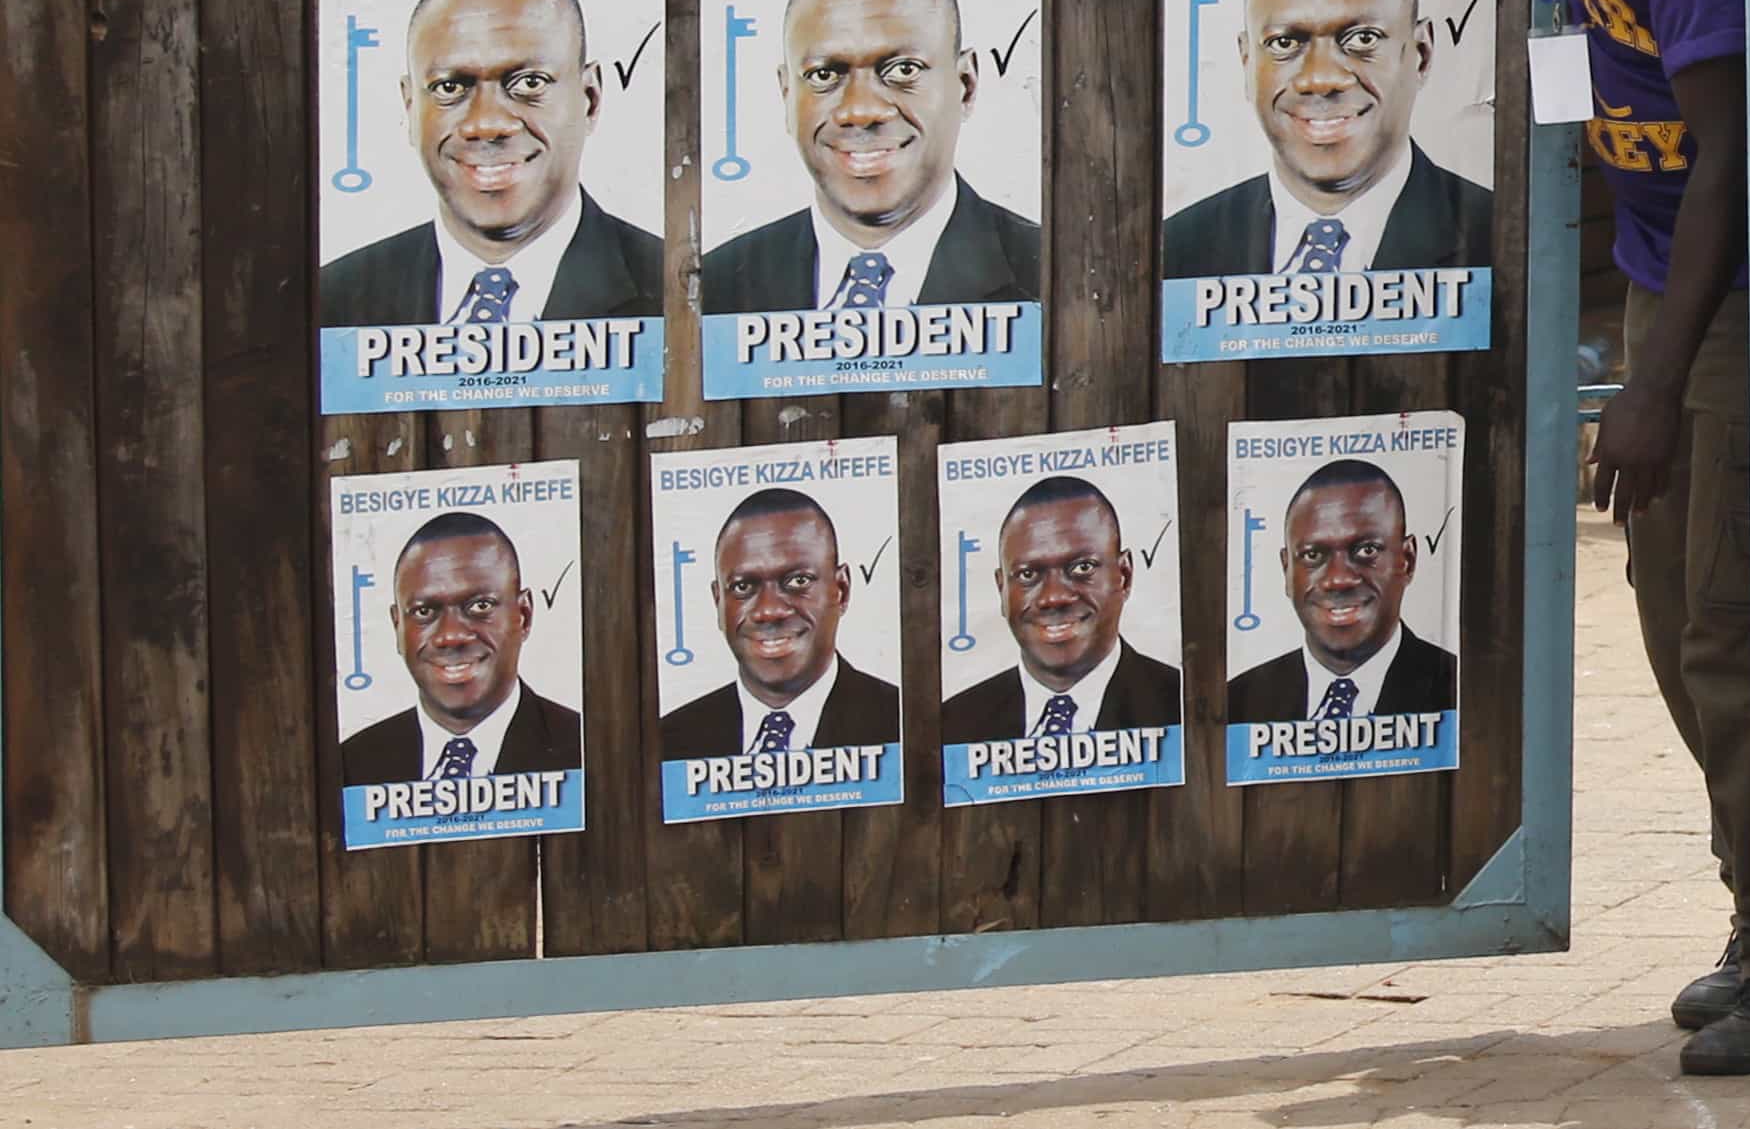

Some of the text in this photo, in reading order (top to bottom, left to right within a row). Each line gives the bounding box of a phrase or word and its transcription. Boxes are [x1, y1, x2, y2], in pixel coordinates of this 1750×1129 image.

[1196, 270, 1468, 327] PRESIDENT
[738, 304, 1018, 363] PRESIDENT
[1220, 332, 1438, 351] FOR THE CHANGE WE DESERVE
[1291, 324, 1356, 334] 2016-2021
[357, 318, 639, 378] PRESIDENT
[836, 359, 902, 370] 2016-2021
[384, 391, 414, 403] FOR
[419, 390, 447, 402] THE
[452, 388, 512, 400] CHANGE
[518, 387, 539, 398] WE
[459, 375, 526, 386] 2016-2021
[764, 368, 987, 388] FOR THE CHANGE WE DESERVE
[946, 439, 1169, 481] BESIGYE KIZZA KIFEFE
[1236, 428, 1456, 459] BESIGYE KIZZA KIFEFE
[660, 455, 891, 490] BESIGYE KIZZA KIFEFE
[340, 478, 572, 514] BESIGYE KIZZA KIFEFE
[968, 726, 1164, 779] PRESIDENT
[1249, 711, 1440, 759] PRESIDENT
[686, 744, 883, 795] PRESIDENT
[365, 769, 564, 821] PRESIDENT
